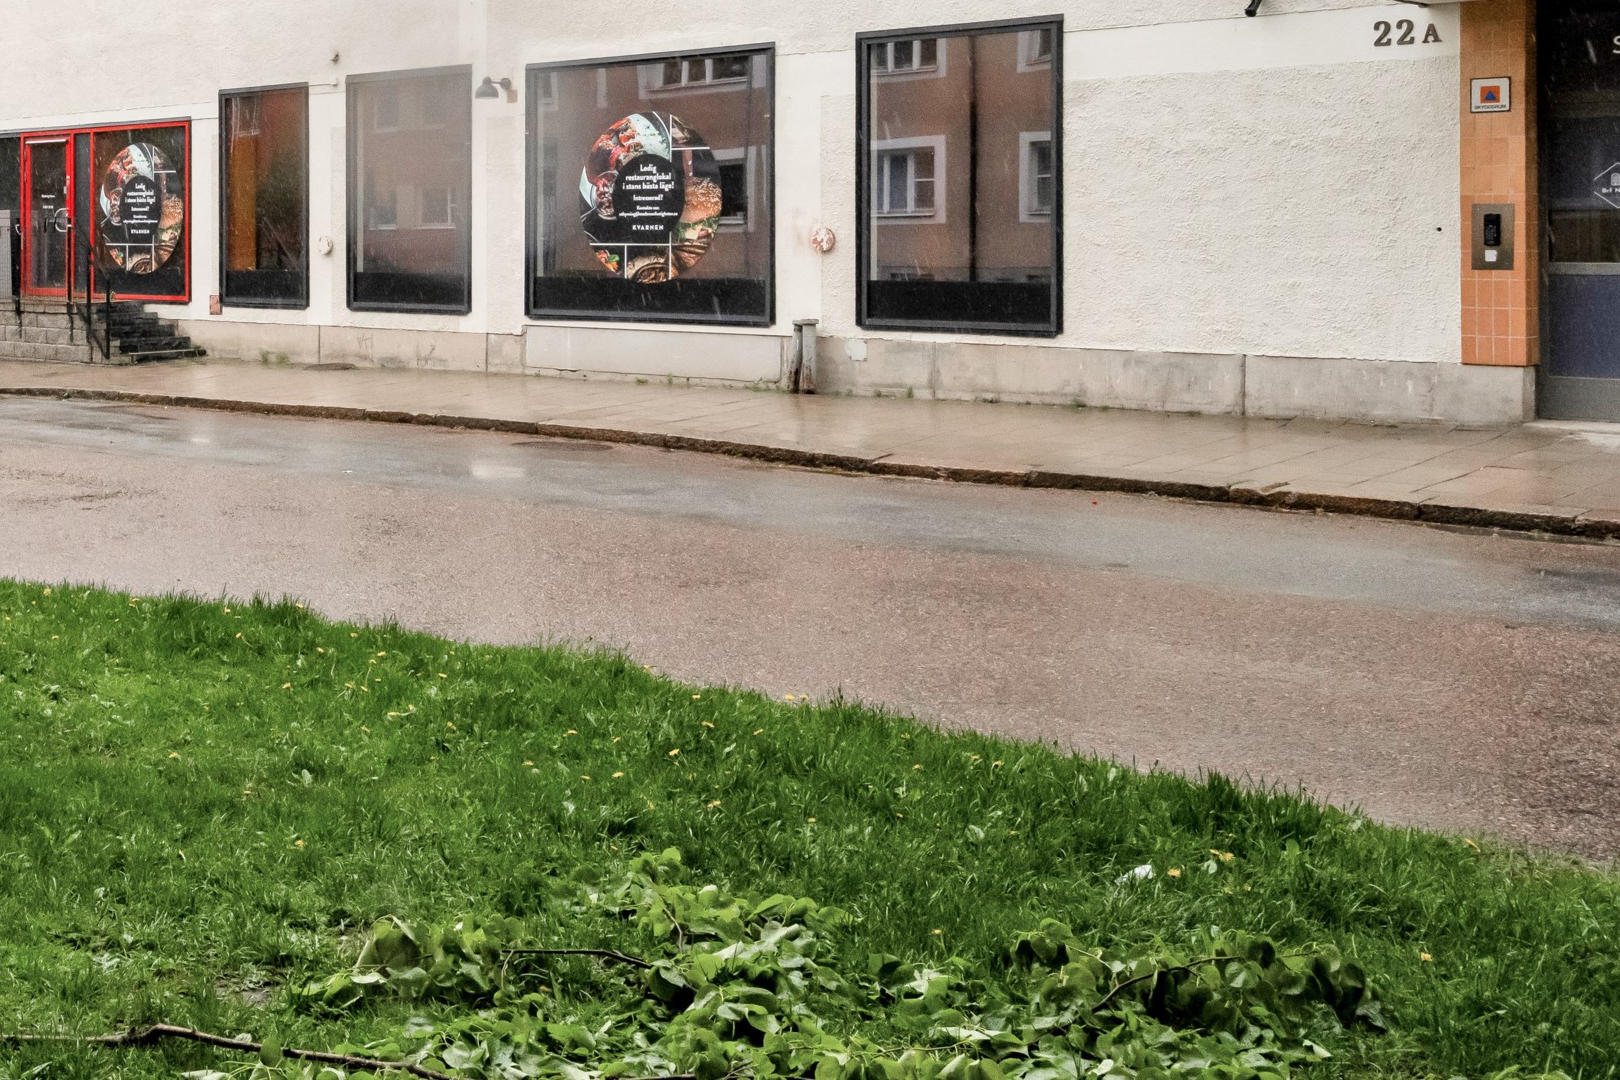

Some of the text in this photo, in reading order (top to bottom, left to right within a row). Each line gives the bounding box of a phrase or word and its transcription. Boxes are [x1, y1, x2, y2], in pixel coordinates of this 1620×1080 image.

[640, 164, 657, 174] Ledig
[625, 172, 672, 183] restauranglokal
[642, 182, 658, 190] bästa
[659, 181, 674, 192] läge!
